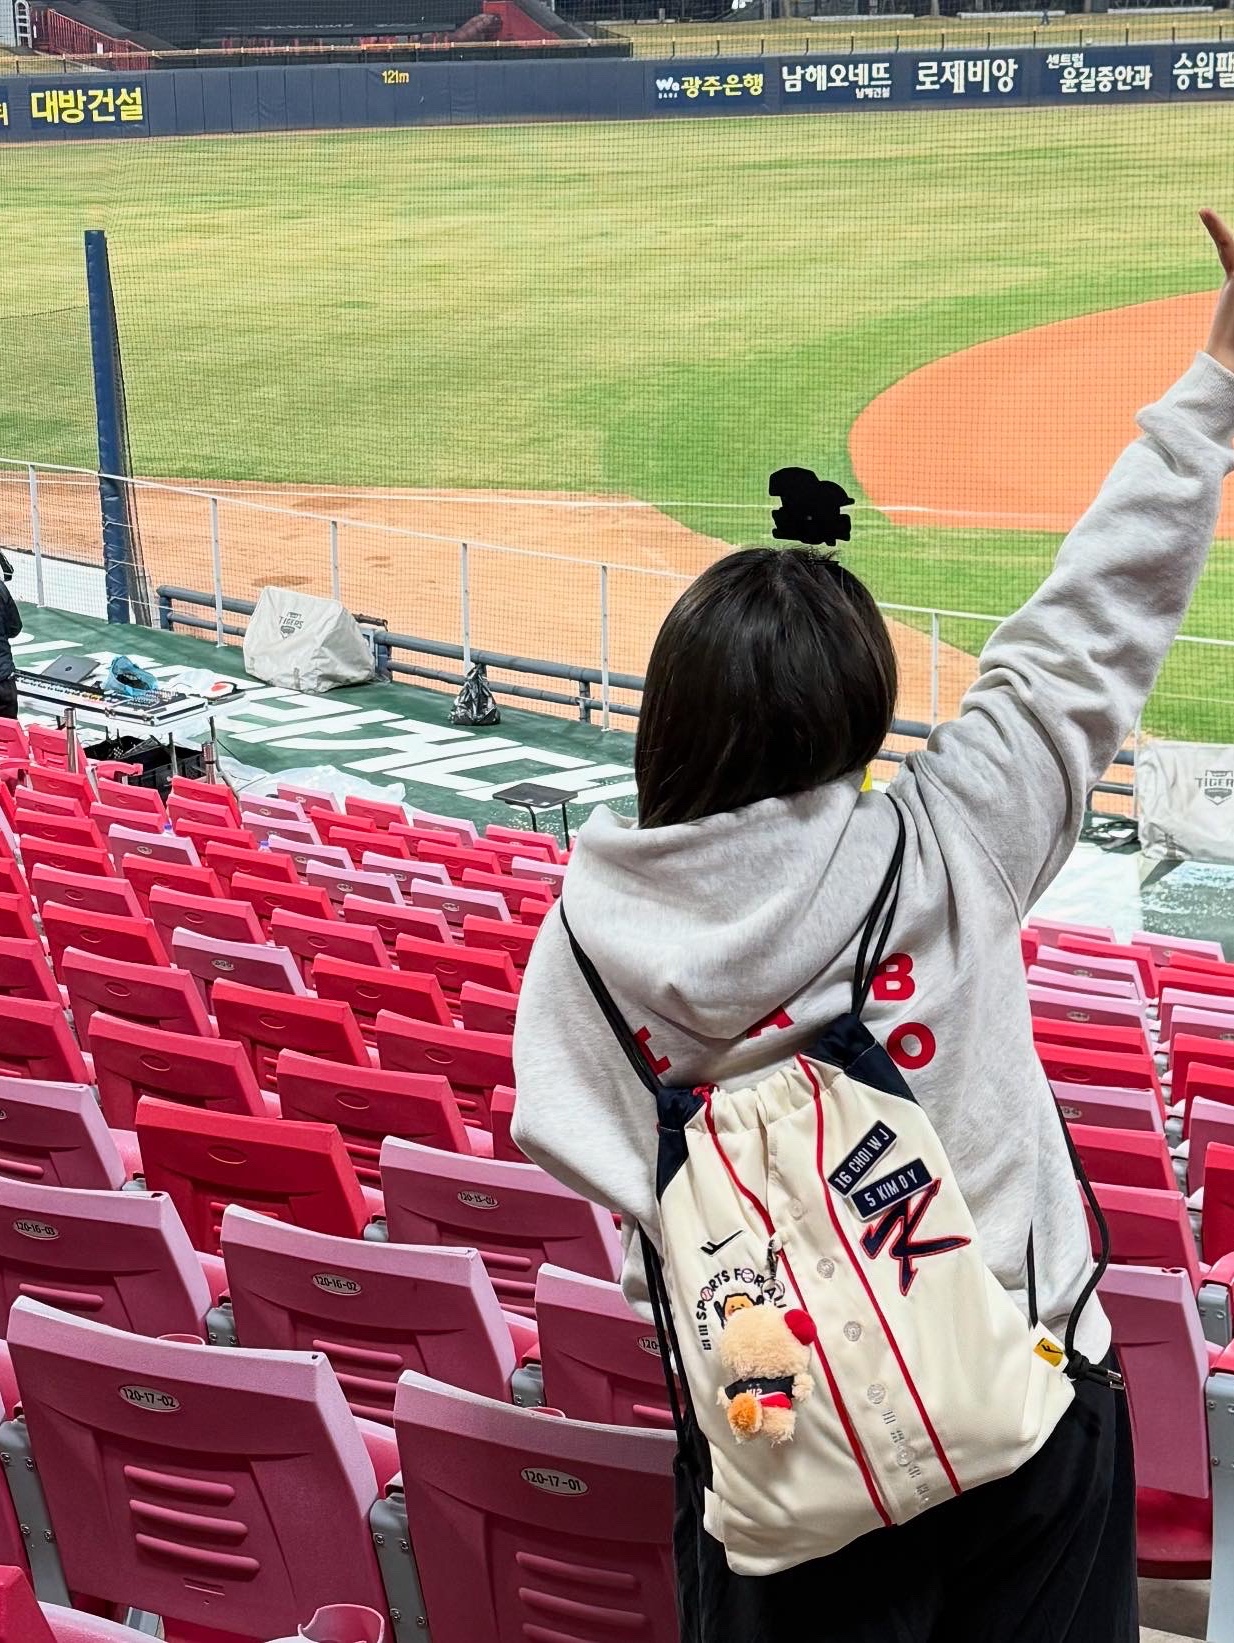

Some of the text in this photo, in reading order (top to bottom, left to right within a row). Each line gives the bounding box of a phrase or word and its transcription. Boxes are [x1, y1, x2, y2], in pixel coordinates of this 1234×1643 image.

[382, 70, 409, 84] 121m
[681, 74, 763, 98] 광주은행
[916, 59, 1018, 93] 로제비앙
[1060, 65, 1153, 92] 윤길중안과
[30, 88, 144, 124] 대방건설
[834, 1128, 890, 1189] 16 CHOI W J
[864, 1192, 877, 1207] 5
[876, 1180, 900, 1201] KIM
[315, 1275, 358, 1291] 120-16-02
[122, 1387, 176, 1408] 120-17-02
[524, 1469, 582, 1492] 120-17-01
